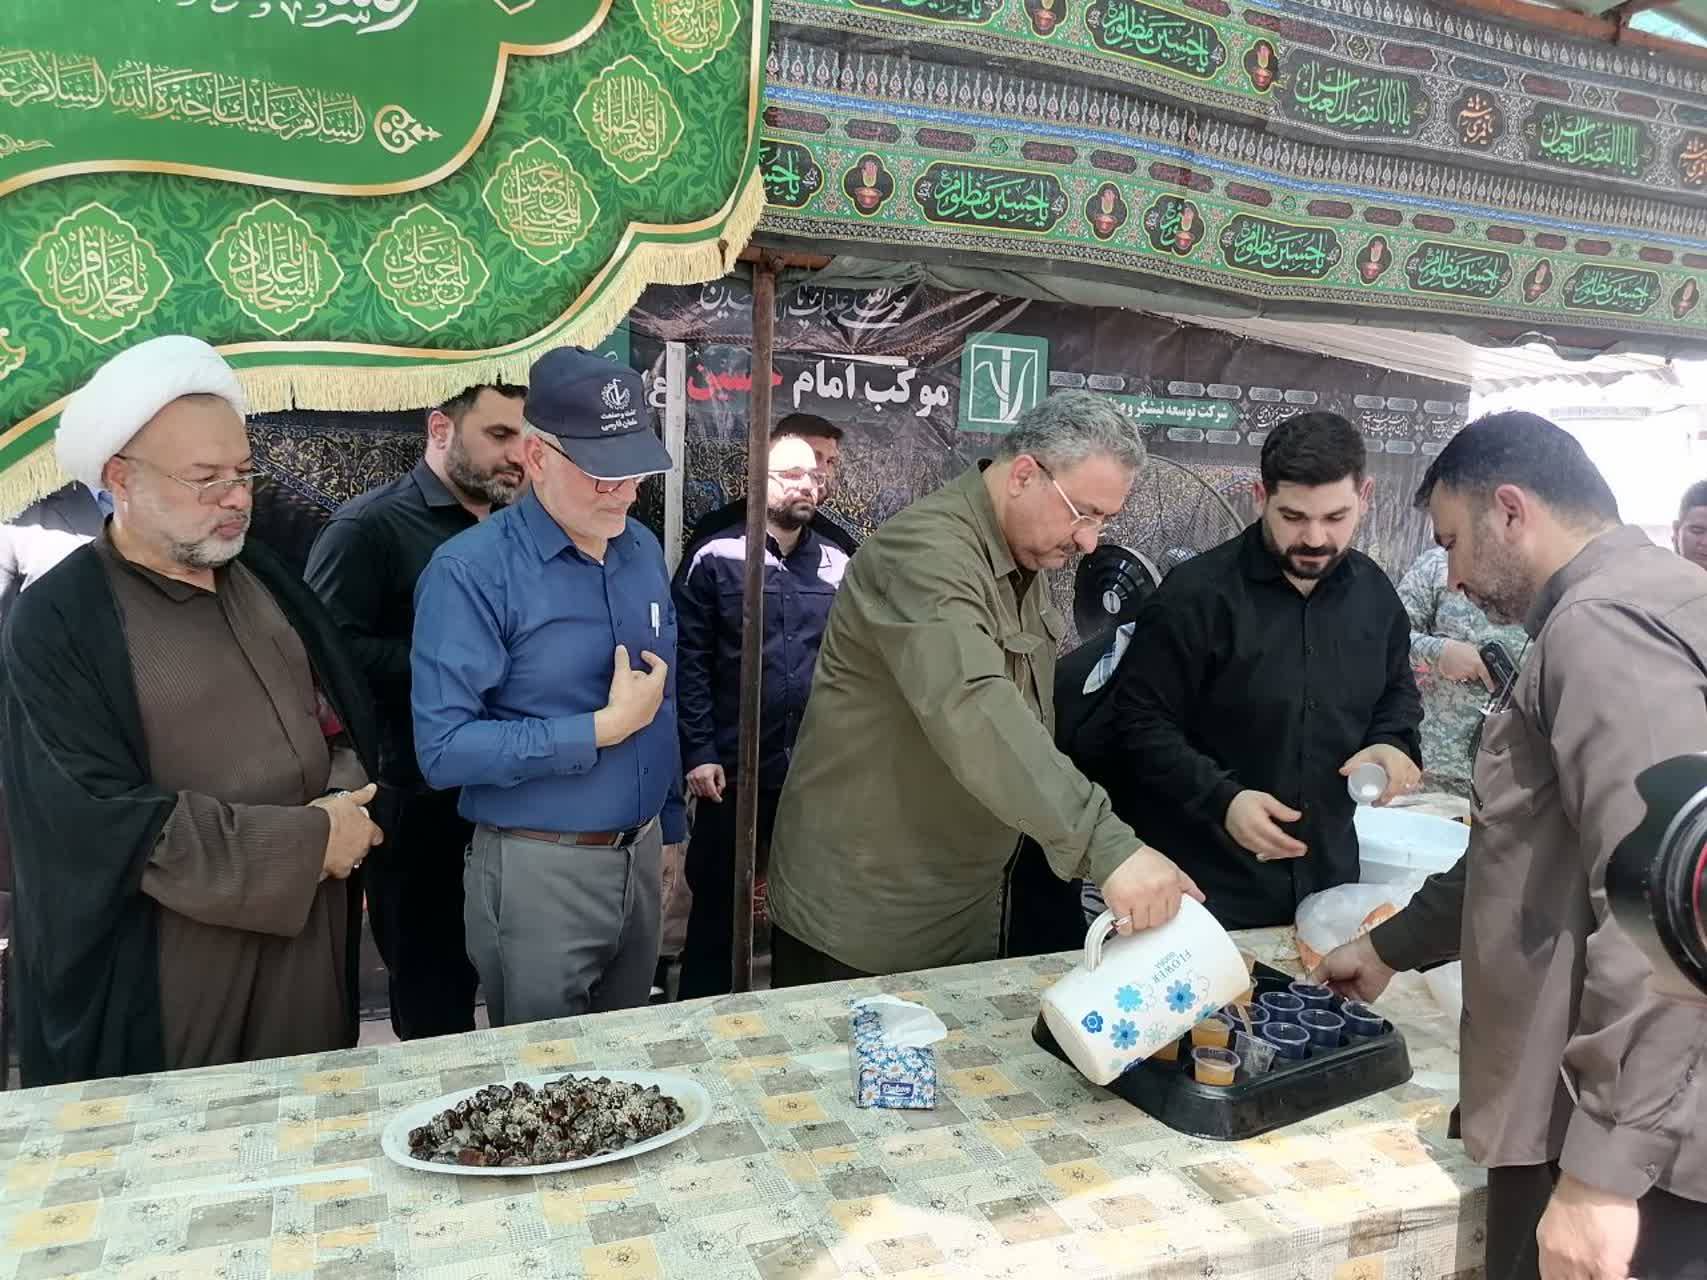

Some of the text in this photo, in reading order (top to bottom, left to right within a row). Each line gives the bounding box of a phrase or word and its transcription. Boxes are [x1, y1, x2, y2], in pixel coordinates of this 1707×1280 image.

[793, 360, 856, 409] امام
[1127, 403, 1134, 416] و
[1134, 400, 1165, 419] نیشکر
[1165, 403, 1197, 421] توسعه
[1197, 404, 1229, 423] شرکت
